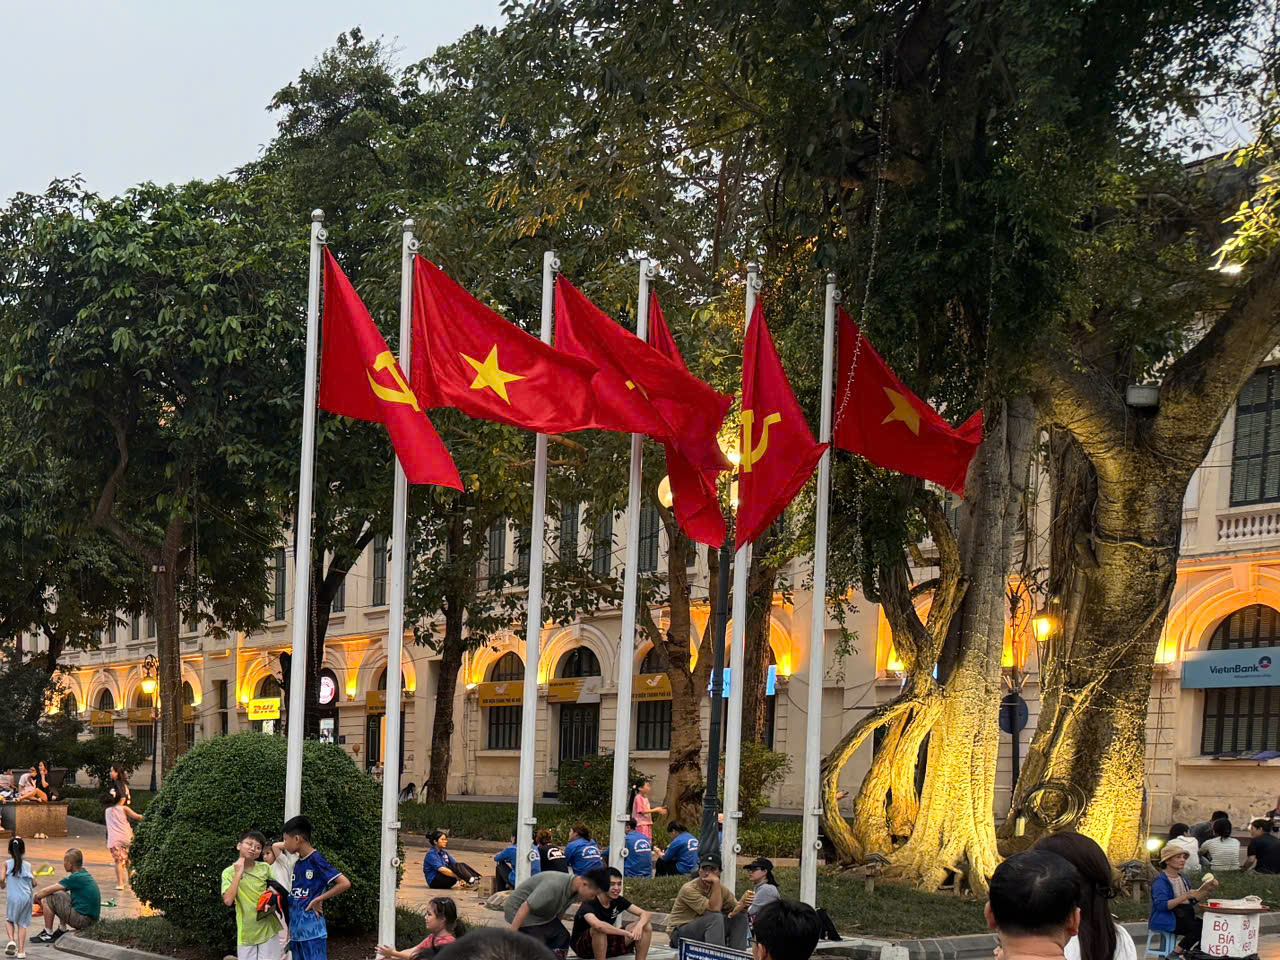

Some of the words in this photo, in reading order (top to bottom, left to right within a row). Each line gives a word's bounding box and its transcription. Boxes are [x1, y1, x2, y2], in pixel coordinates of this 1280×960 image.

[1209, 664, 1259, 675] VietinBank
[253, 704, 275, 714] DHL
[1213, 919, 1229, 931] BÒ
[1218, 932, 1235, 944] BÍA
